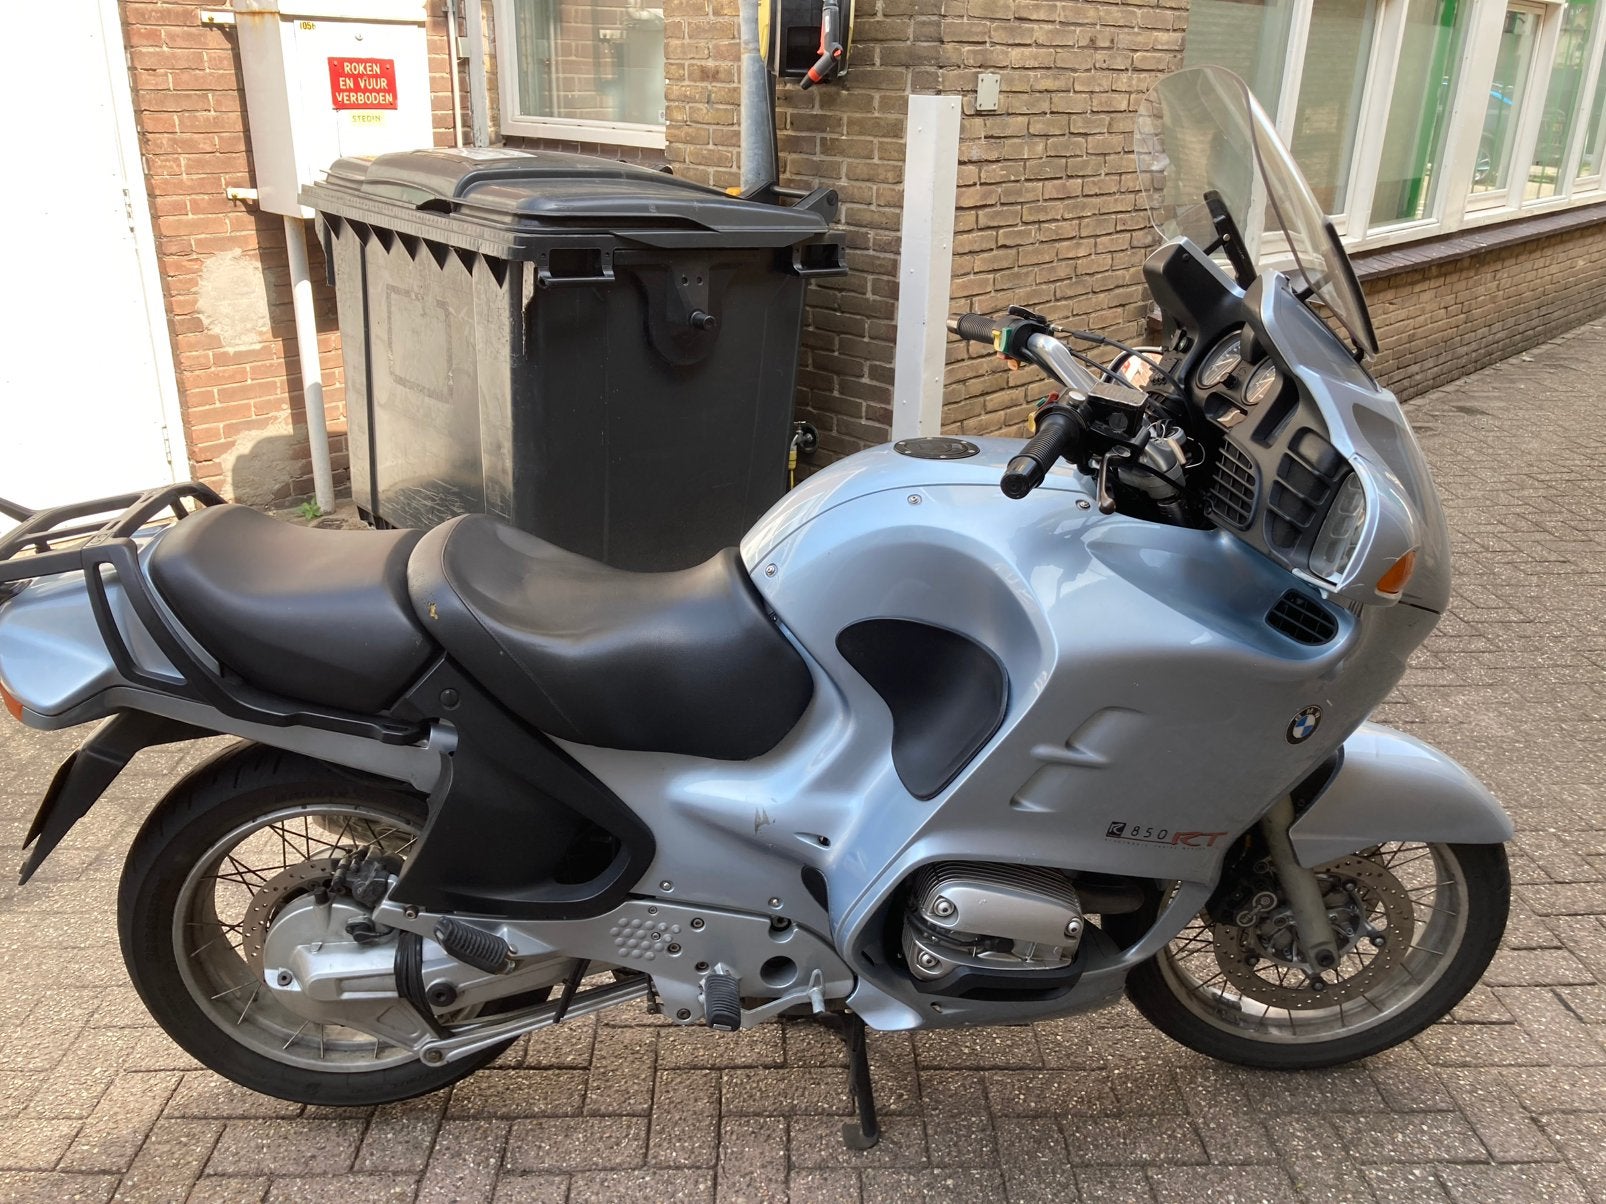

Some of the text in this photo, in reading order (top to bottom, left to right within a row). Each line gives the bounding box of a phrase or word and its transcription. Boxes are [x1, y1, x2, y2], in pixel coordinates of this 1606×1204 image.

[344, 62, 380, 75] ROKEN
[339, 77, 388, 89] EN VUUR
[335, 92, 393, 104] VERBODEN
[1131, 825, 1168, 840] 850
[1171, 832, 1228, 847] RT
